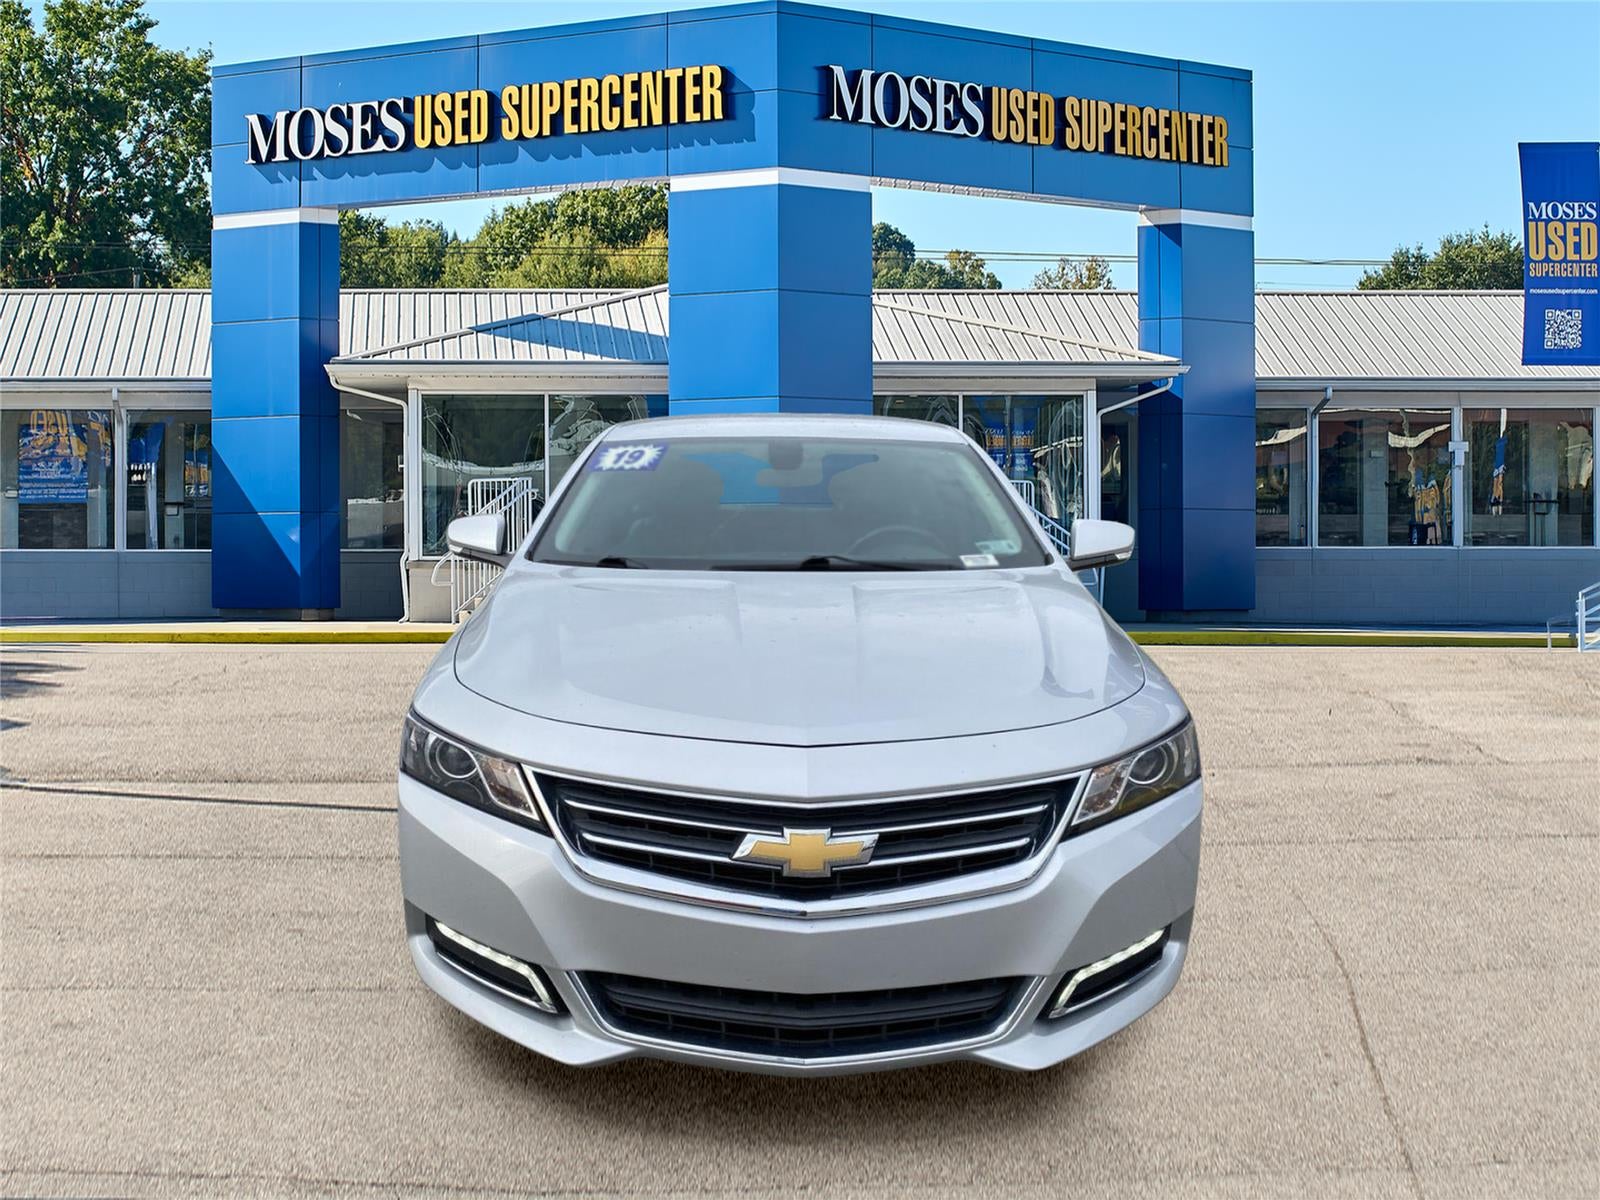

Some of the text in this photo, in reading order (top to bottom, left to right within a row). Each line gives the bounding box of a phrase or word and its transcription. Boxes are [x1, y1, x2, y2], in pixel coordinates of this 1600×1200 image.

[243, 64, 724, 165] MOSES USED SUPERCENTER
[828, 65, 1230, 167] MOSES USED SUPERCENTER
[1527, 201, 1597, 220] MOSES
[1528, 221, 1598, 261] USED
[1529, 263, 1598, 278] SUPERCENTER
[613, 449, 646, 465] 19
